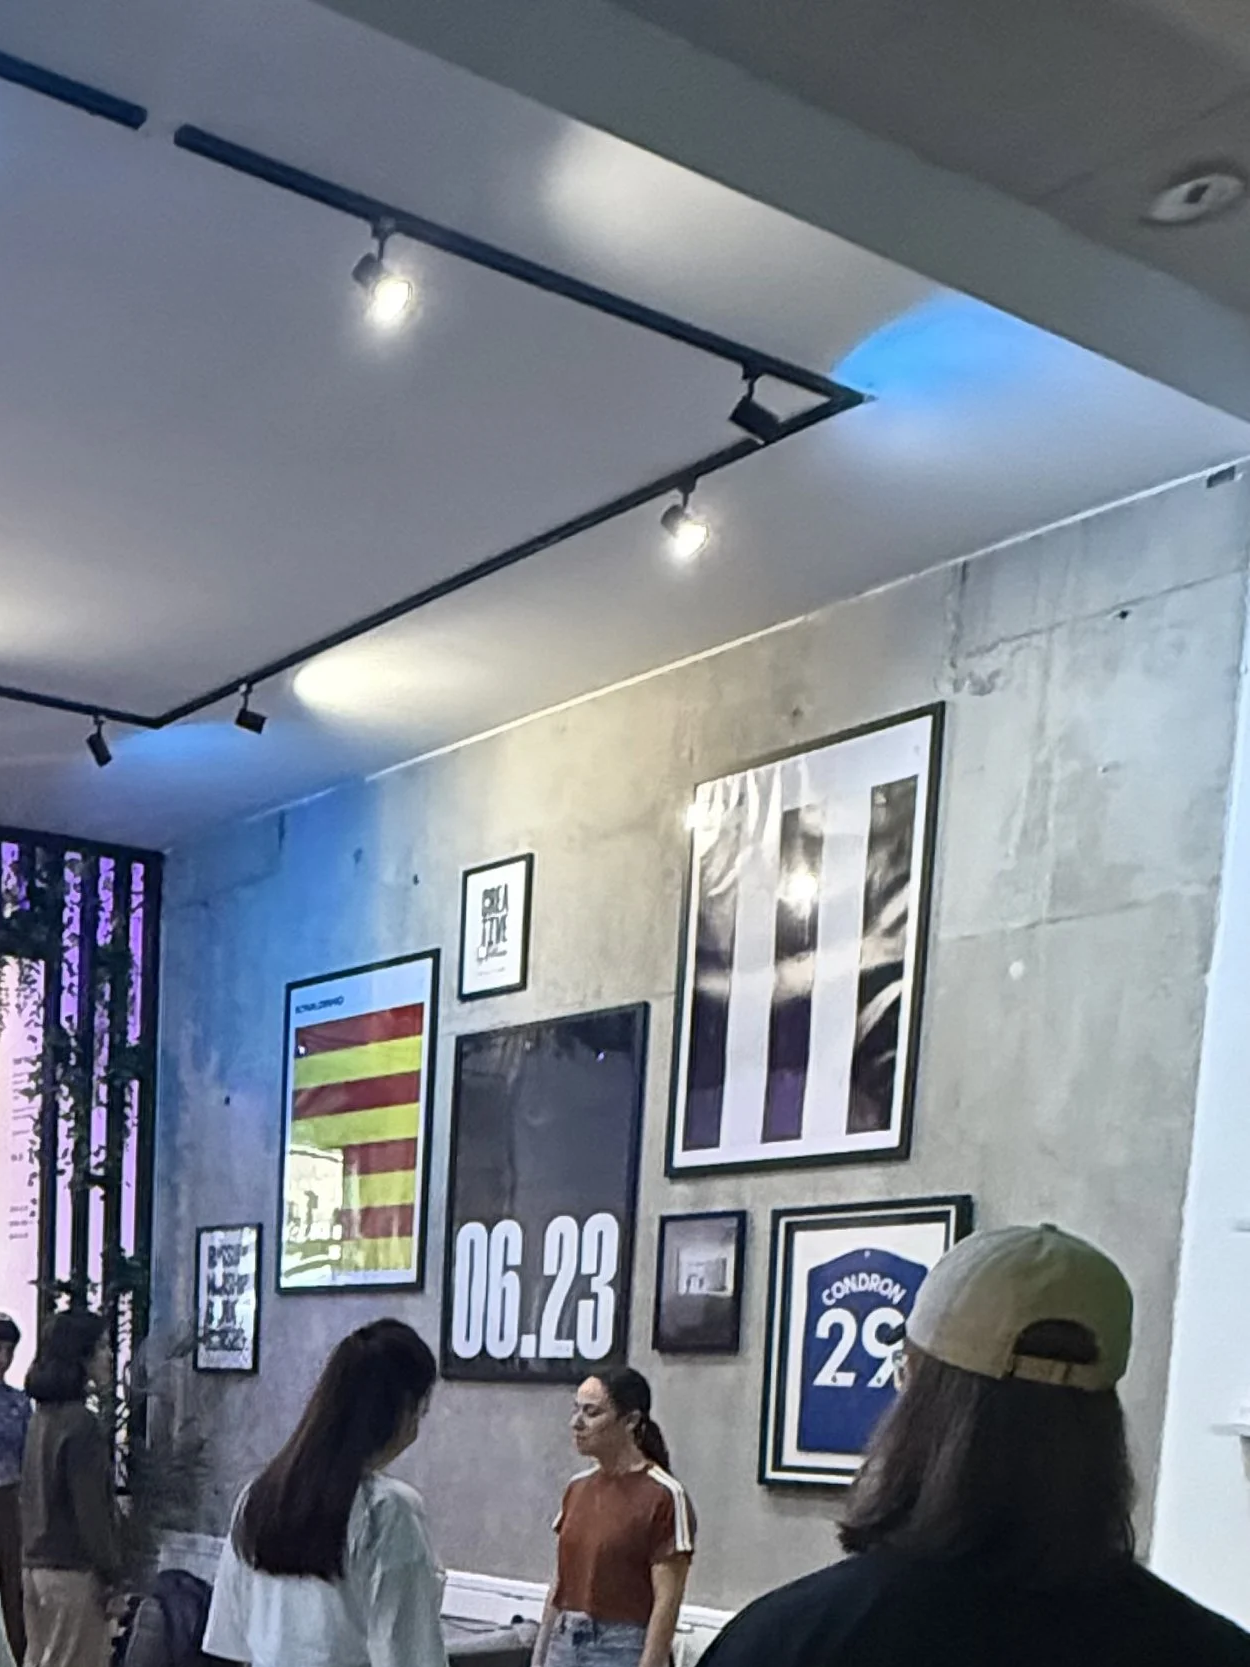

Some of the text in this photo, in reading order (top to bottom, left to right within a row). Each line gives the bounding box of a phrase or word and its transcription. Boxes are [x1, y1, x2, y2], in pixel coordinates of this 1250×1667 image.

[452, 1212, 619, 1360] 06.23
[821, 1272, 907, 1307] CONDRON
[813, 1307, 906, 1388] 29
